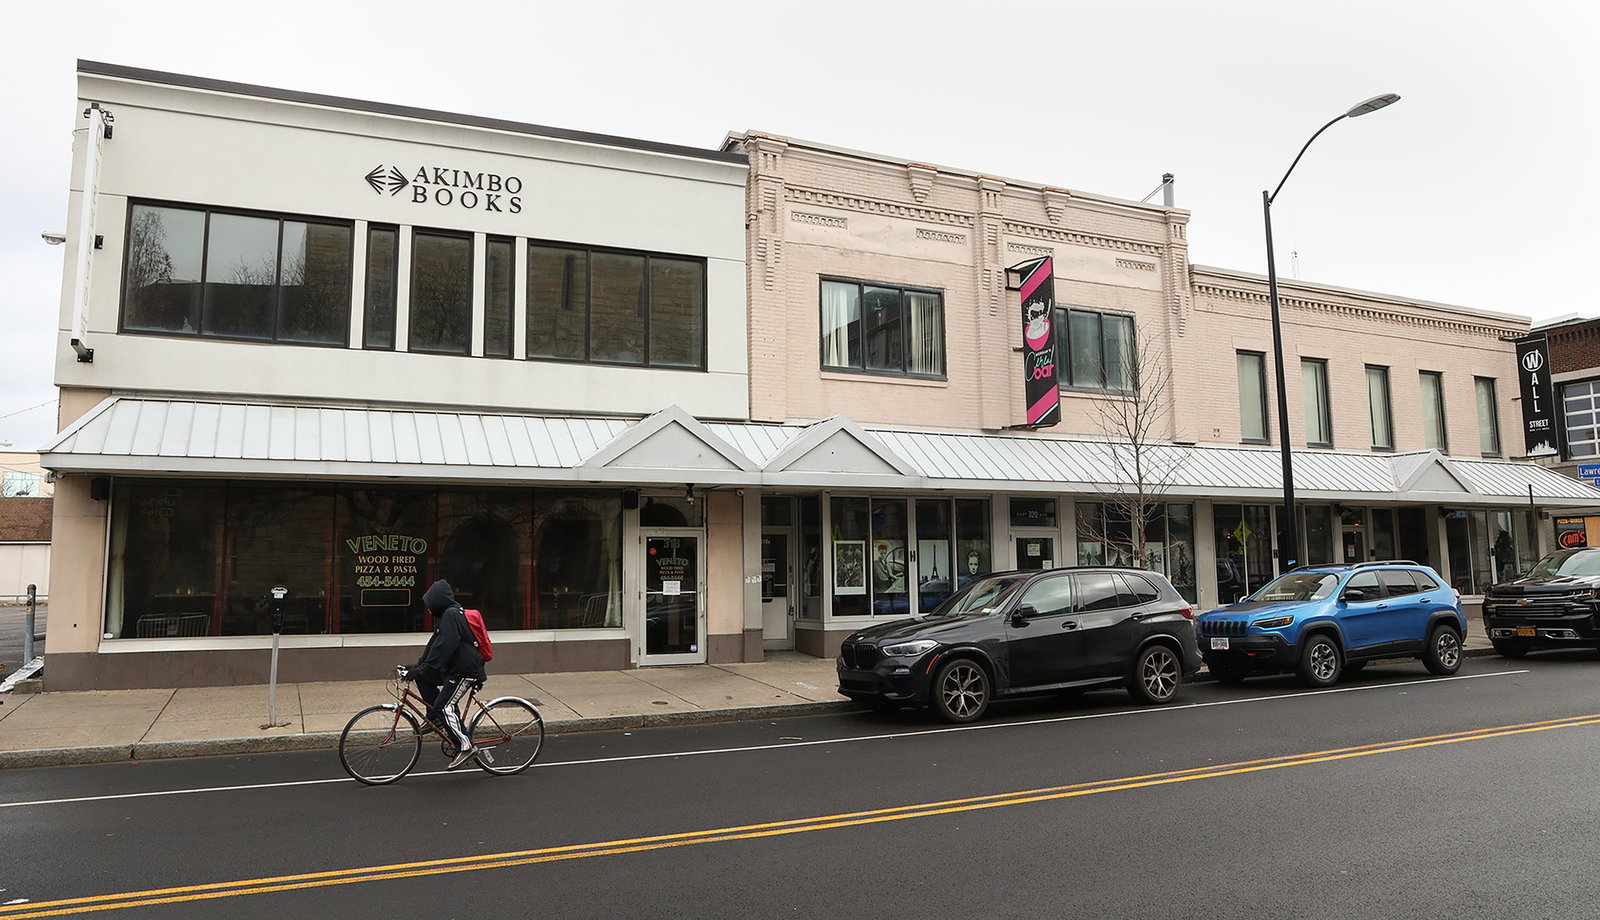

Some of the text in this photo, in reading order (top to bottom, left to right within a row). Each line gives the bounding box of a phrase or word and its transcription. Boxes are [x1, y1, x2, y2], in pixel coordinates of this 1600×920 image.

[412, 165, 523, 194] AKIMBO
[411, 184, 522, 214] BOOKS
[1033, 364, 1054, 380] bar
[1524, 349, 1542, 413] WALL
[1529, 418, 1549, 429] STREET
[346, 534, 428, 555] VENETO
[358, 555, 416, 564] WOOD FIRED
[656, 557, 688, 567] VENETO
[355, 565, 418, 574] PIZZA & PASTA
[356, 575, 416, 587] 454-5444
